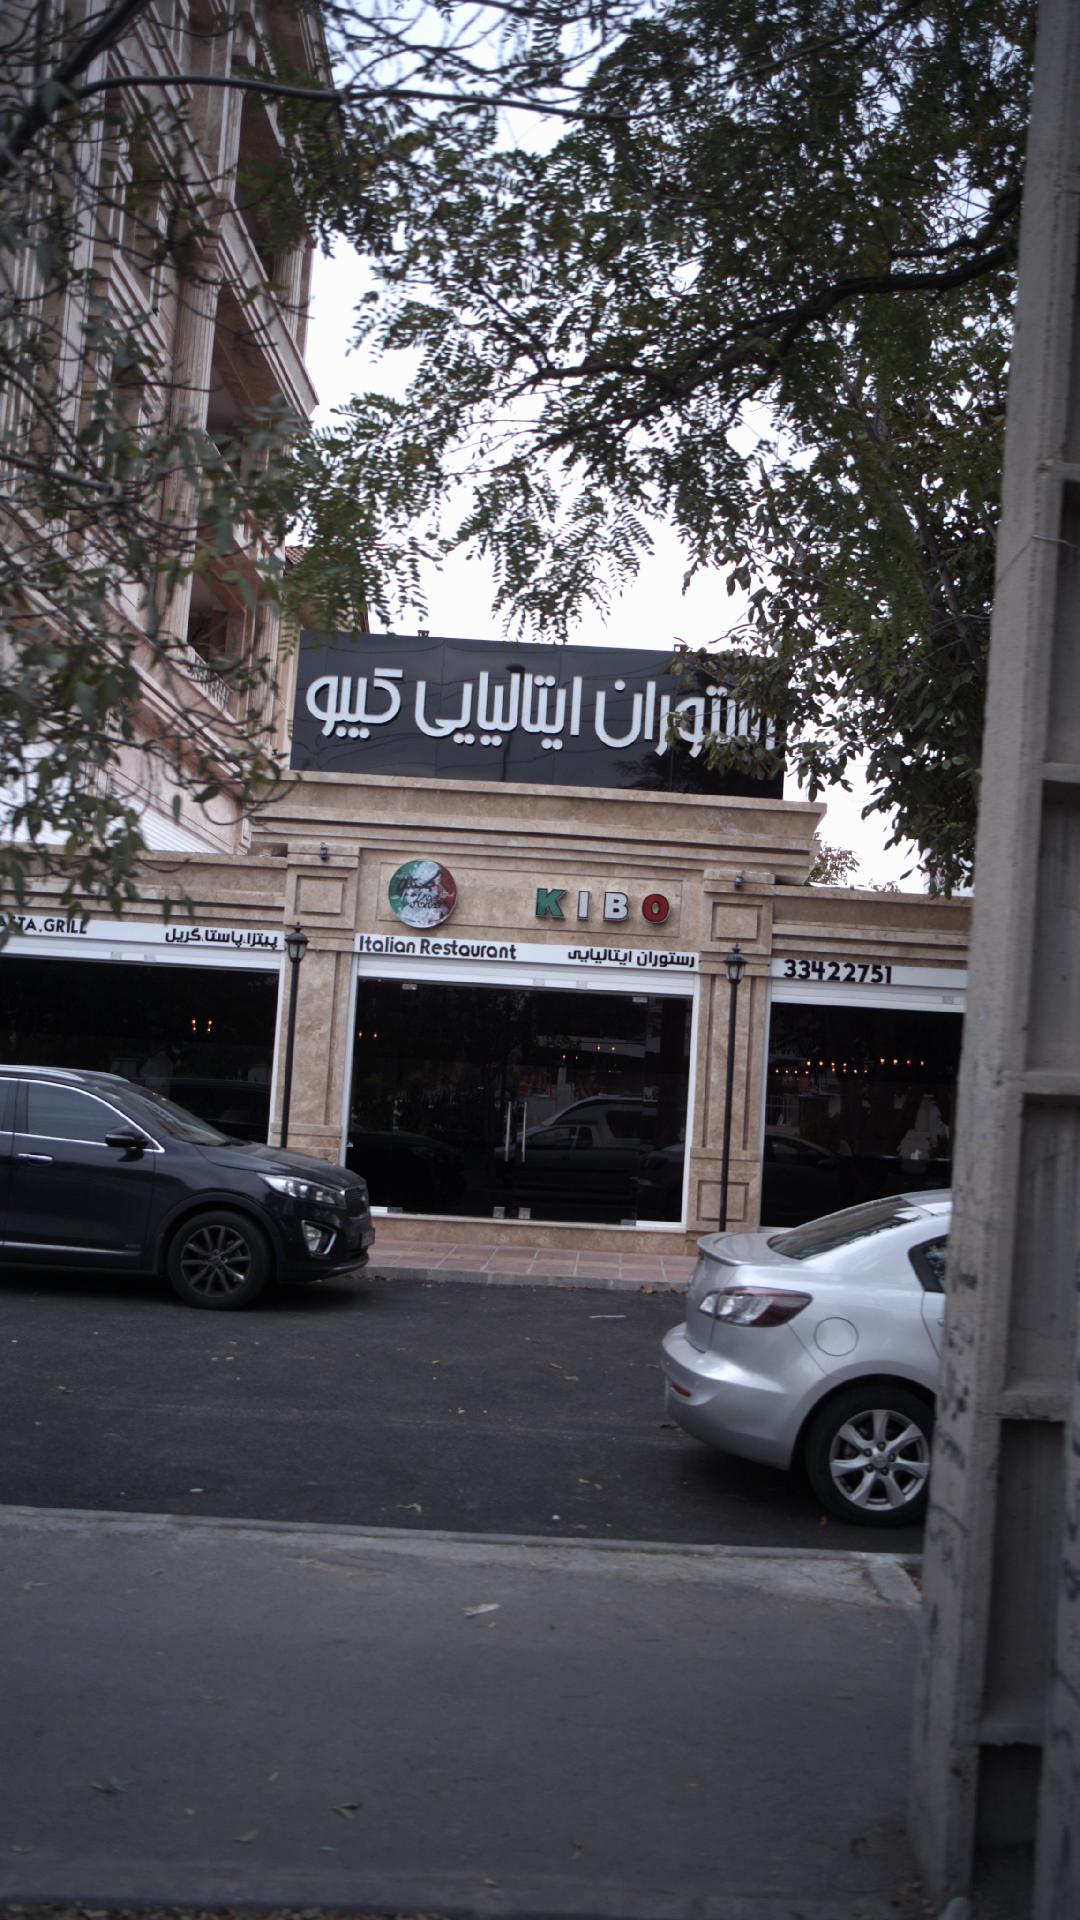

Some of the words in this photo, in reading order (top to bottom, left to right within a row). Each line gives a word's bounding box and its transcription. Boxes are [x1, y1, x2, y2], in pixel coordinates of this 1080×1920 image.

[414, 670, 582, 750] ایتالیایی
[535, 887, 670, 924] KIBO
[359, 935, 415, 953] Italian
[420, 938, 517, 960] Restaurant
[568, 948, 632, 966] ایتالیایی
[637, 951, 695, 968] رستوران
[784, 959, 893, 985] 33422751
